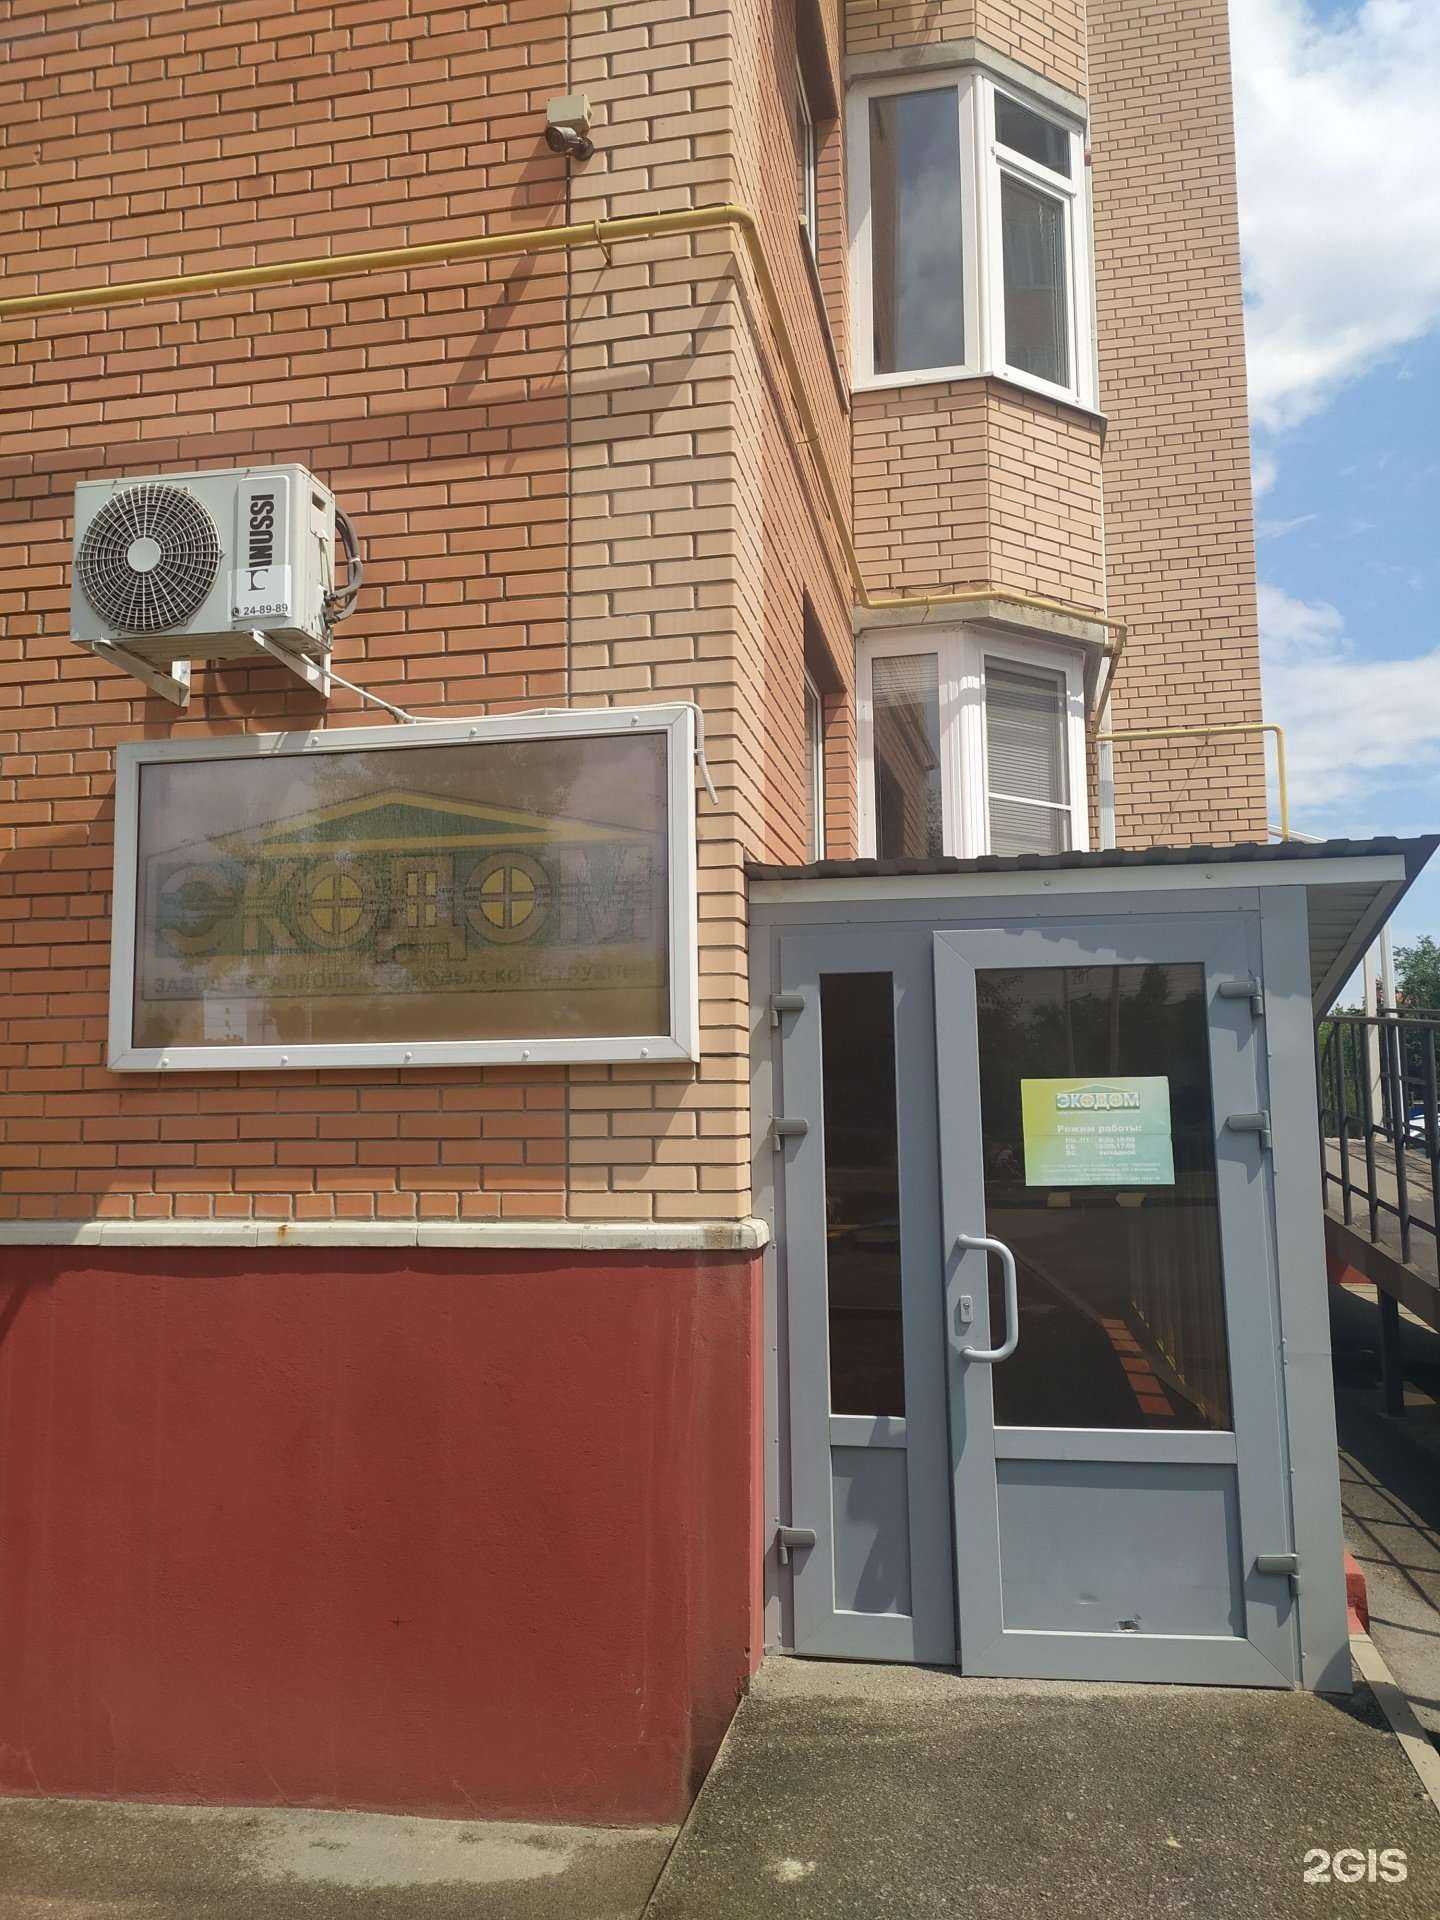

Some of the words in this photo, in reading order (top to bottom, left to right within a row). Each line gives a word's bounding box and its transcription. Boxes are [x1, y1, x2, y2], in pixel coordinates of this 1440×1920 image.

[243, 603, 288, 616] 24-89-89
[160, 848, 653, 962] ЭКОДОМ
[1056, 1093, 1140, 1110] ЭКОДОМ
